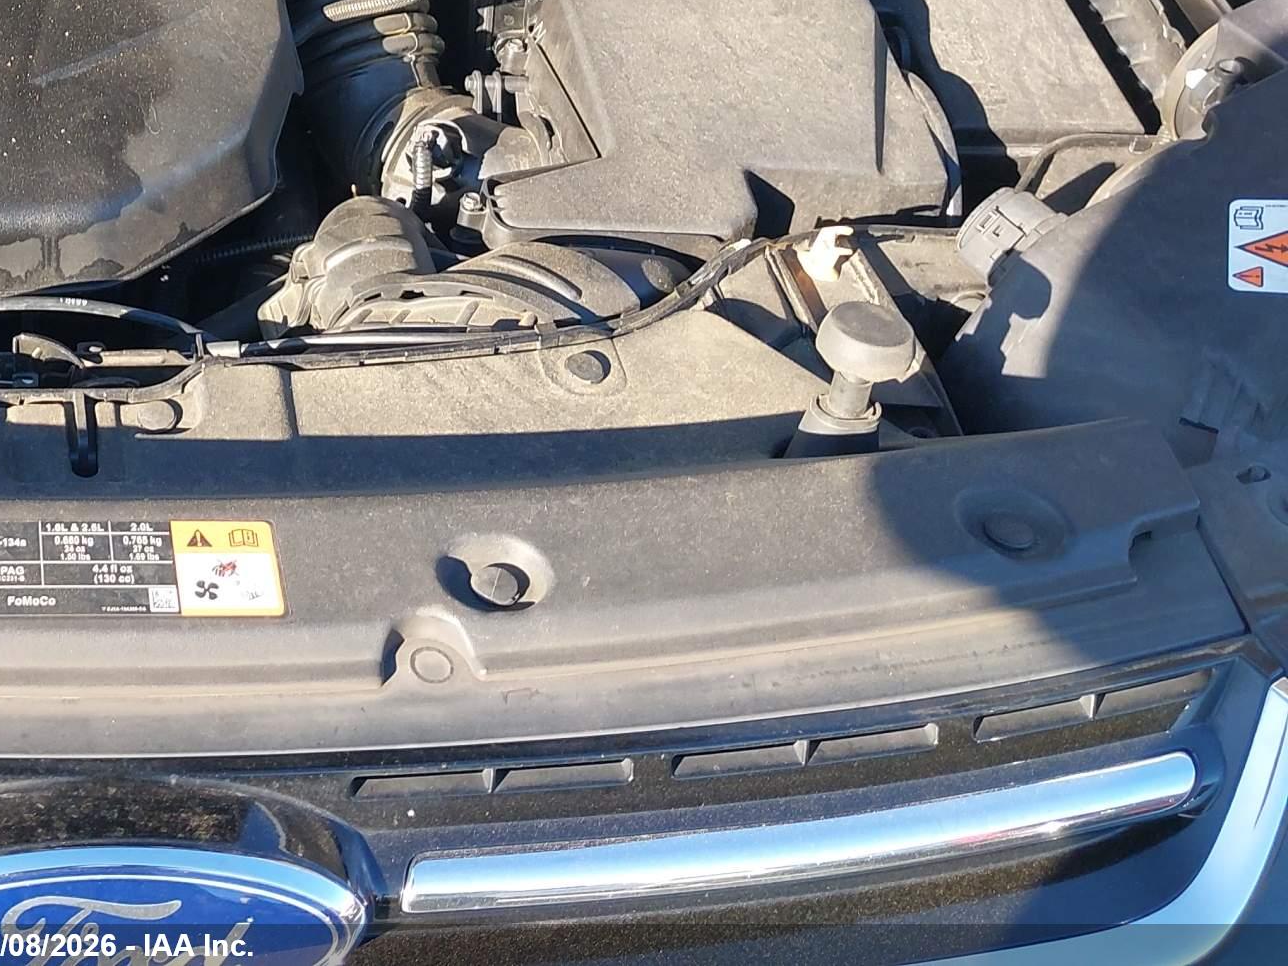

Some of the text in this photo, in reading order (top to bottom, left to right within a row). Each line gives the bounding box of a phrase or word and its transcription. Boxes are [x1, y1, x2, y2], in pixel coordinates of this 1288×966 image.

[70, 522, 80, 532] &
[130, 522, 153, 532] 2.0L
[81, 535, 94, 547] kg
[150, 536, 163, 547] kg
[0, 565, 25, 575] PAG
[92, 564, 108, 574] 4.4
[119, 565, 133, 574] oz
[93, 574, 116, 584] (130
[7, 595, 57, 606] FoMoCo
